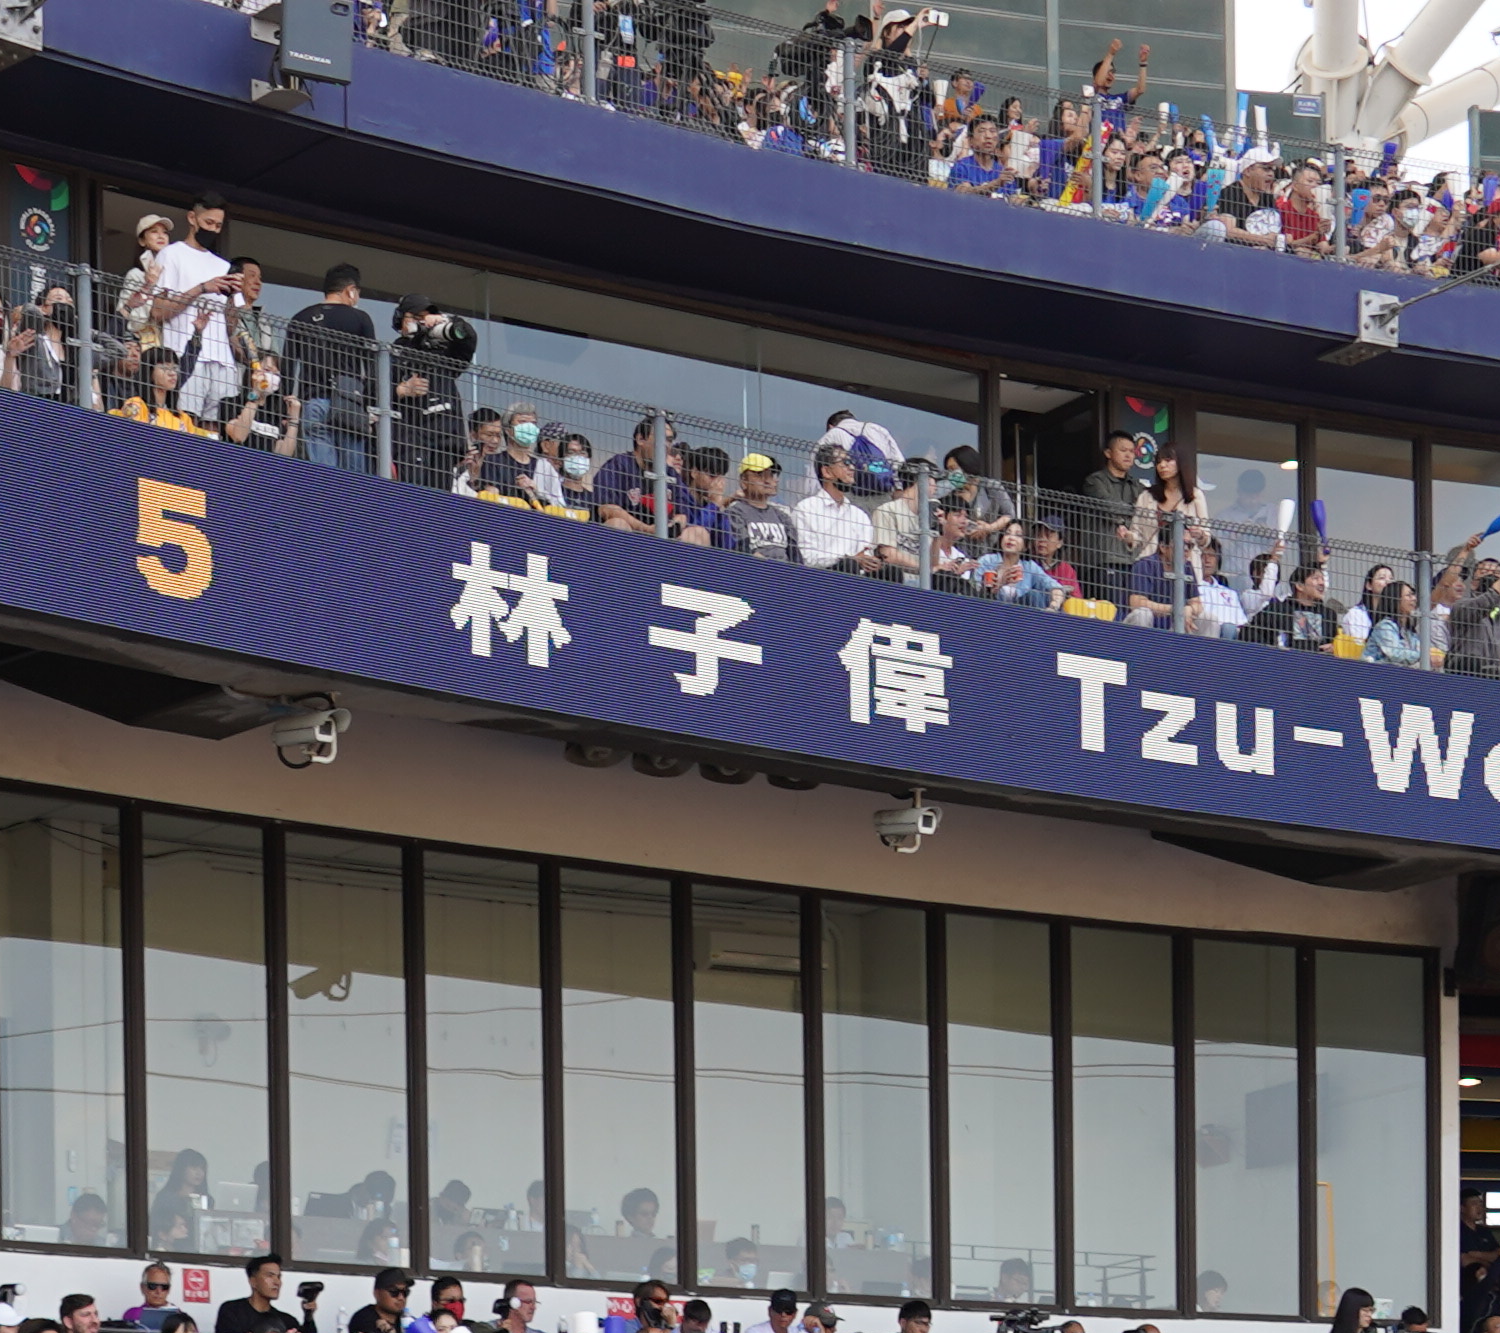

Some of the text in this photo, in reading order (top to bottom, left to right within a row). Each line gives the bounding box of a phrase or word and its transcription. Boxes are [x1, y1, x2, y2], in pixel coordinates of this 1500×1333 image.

[137, 477, 213, 599] 5
[451, 542, 953, 733] 林子偉
